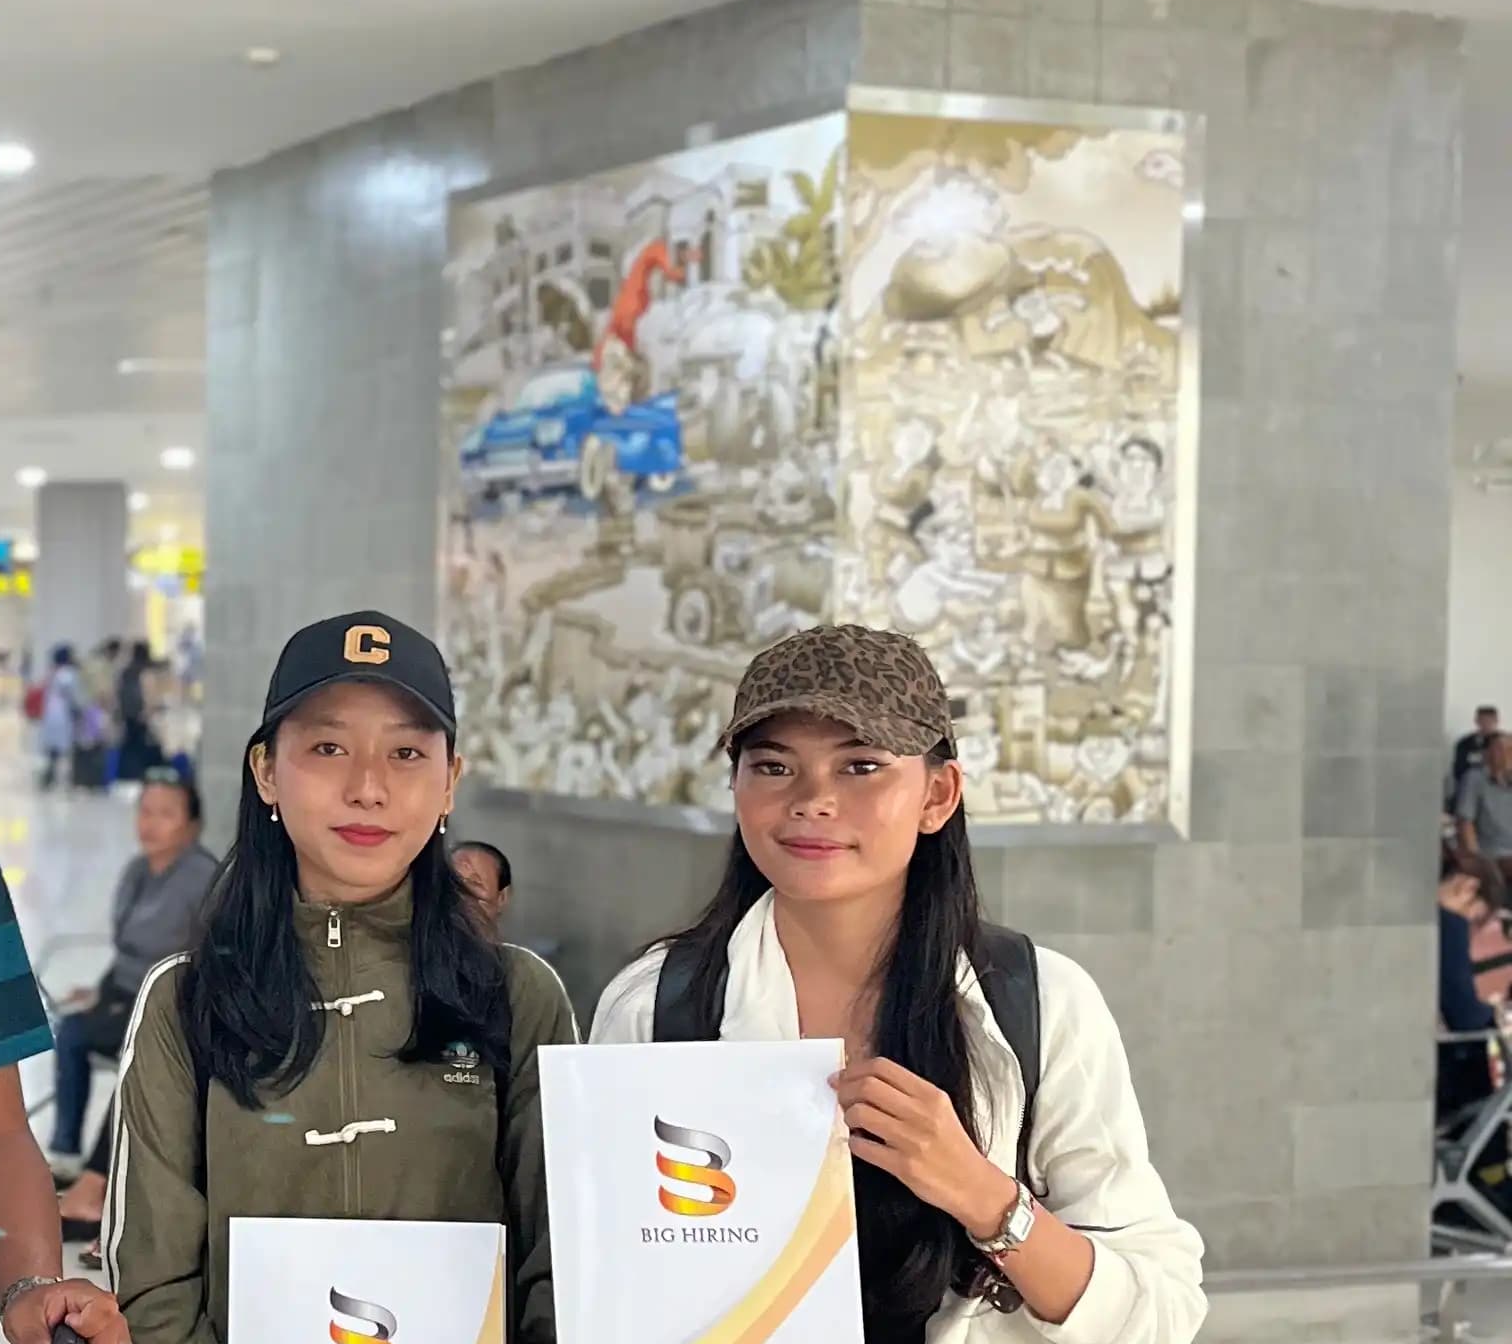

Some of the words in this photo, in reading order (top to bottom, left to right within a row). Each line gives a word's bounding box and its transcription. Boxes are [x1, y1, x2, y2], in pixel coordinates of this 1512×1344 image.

[344, 625, 390, 665] C
[641, 1226, 676, 1244] BIG
[681, 1226, 759, 1244] HIRING
